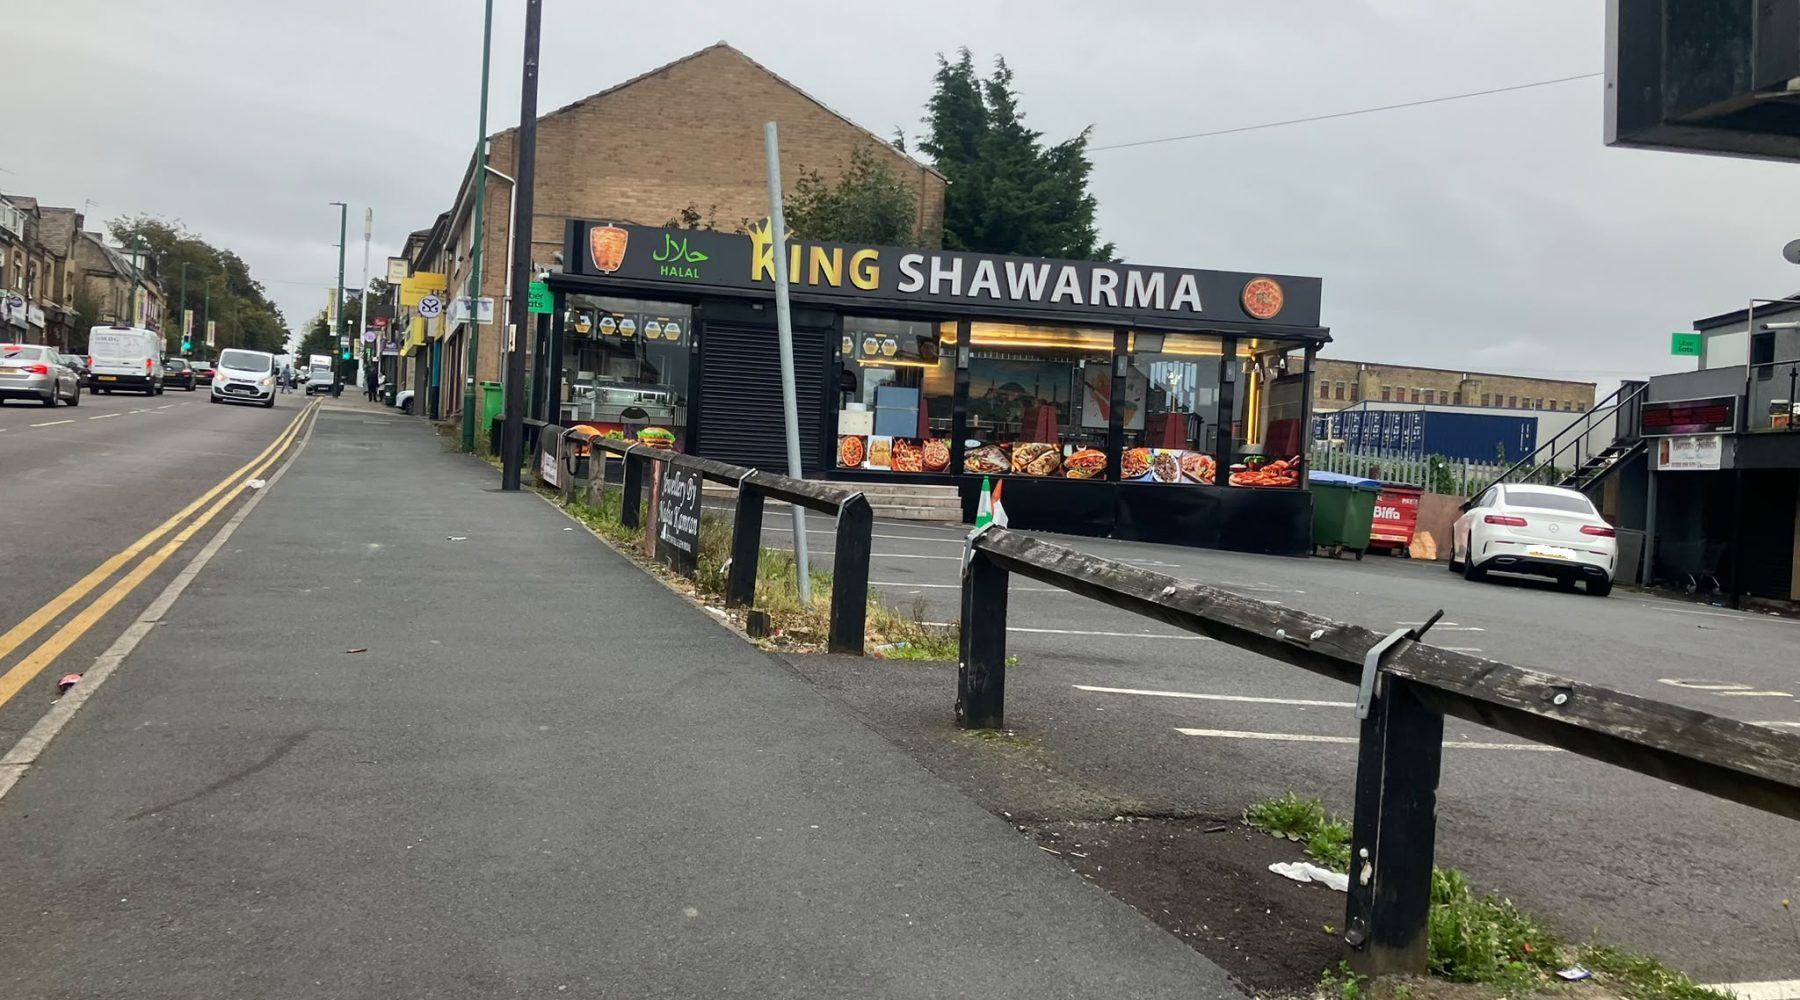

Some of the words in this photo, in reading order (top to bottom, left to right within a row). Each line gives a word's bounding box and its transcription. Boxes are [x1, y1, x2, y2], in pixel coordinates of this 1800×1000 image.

[652, 233, 709, 262] حلال
[660, 265, 700, 279] HALAL
[751, 240, 880, 290] KING
[897, 253, 1203, 313] SHAWARMA
[662, 471, 686, 507] Jewellery
[686, 477, 697, 511] By
[1373, 505, 1401, 520] Biffa
